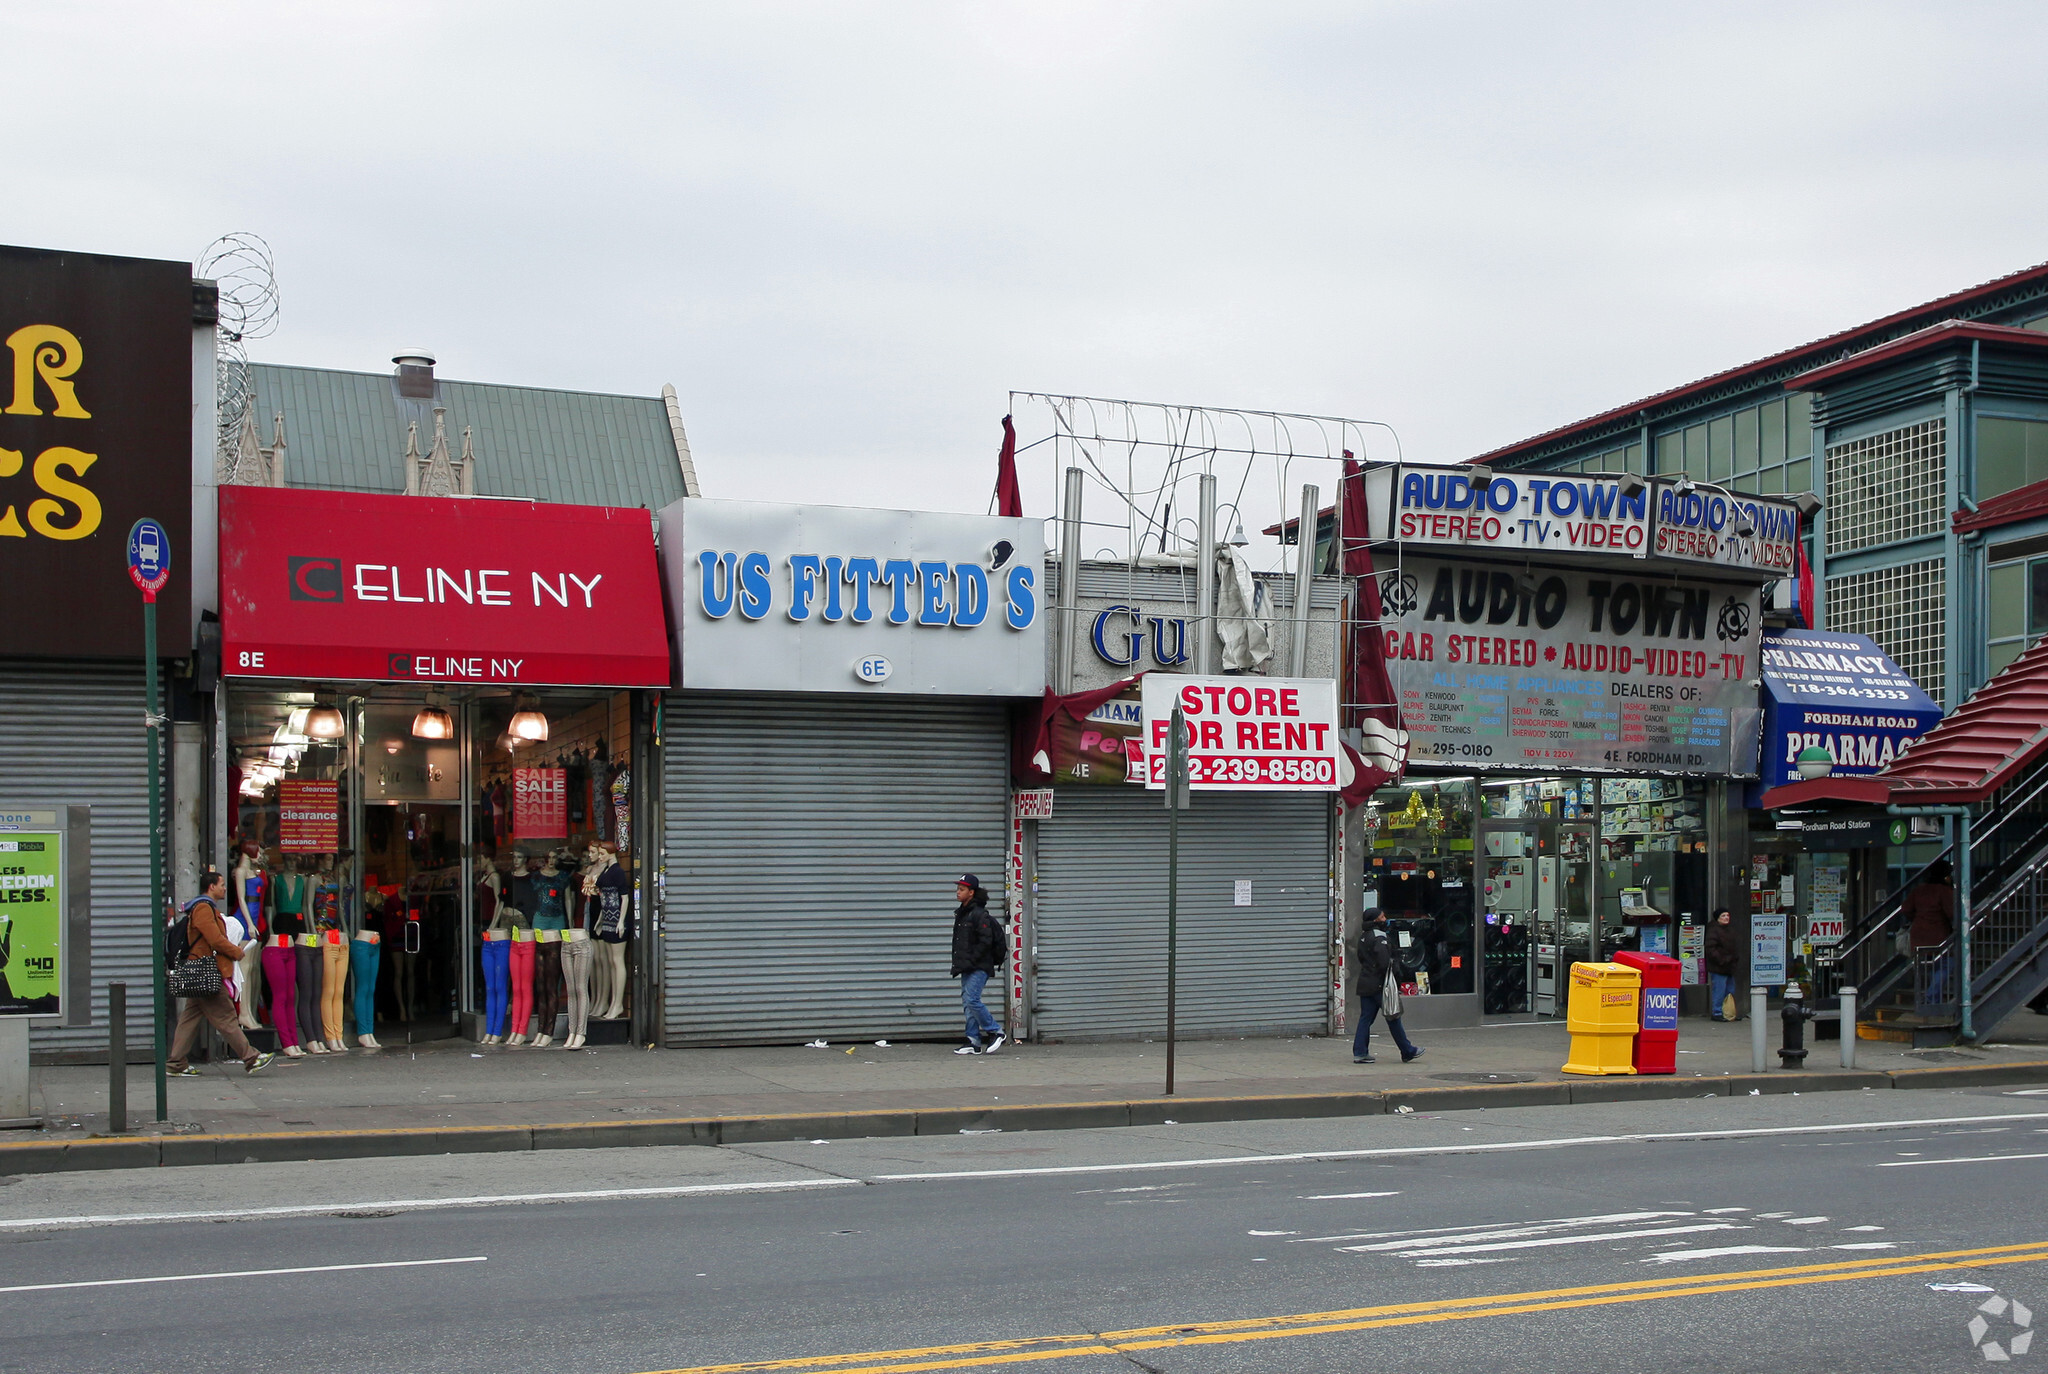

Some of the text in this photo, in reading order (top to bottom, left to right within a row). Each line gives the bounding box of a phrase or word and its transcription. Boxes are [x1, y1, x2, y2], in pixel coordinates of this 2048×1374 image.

[0, 324, 92, 419] R
[1400, 513, 1643, 549] STEREO TV VIDEO
[1657, 527, 1793, 568] STEREO TV VIDEO
[133, 568, 167, 589] NO STANDING
[697, 549, 772, 620] US
[531, 571, 602, 608] NY
[1423, 567, 1710, 640] AUDIO TOWN
[1384, 630, 1434, 661] CAR
[1446, 634, 1537, 667] STEREO
[1823, 641, 1860, 650] ROAD
[238, 651, 264, 668] 8E
[1762, 649, 1889, 675] PHARMACY
[490, 658, 523, 677] NY
[862, 660, 886, 676] 6E
[1432, 672, 1701, 701] ALL HOME APPLIANCES DEALERS OF:
[1787, 683, 1909, 700] 718-364-3333
[1181, 686, 1300, 716] STORE
[1403, 690, 1420, 698] SONY
[1425, 691, 1456, 700] KENWOOD
[1093, 703, 1142, 722] DIAM
[1403, 702, 1424, 710] ALPINE
[1429, 703, 1464, 711] BLAUPUNKT
[1540, 709, 1559, 717] FORCE
[1650, 704, 1670, 712] PENTAX
[1698, 707, 1723, 716] OLYMPUS
[1403, 713, 1425, 721] PHILIPS
[1430, 714, 1451, 722] ZENITH
[1644, 715, 1663, 723] CANON
[1804, 712, 1917, 729] FORDHAM ROAD
[1236, 721, 1330, 750] RENT
[1405, 724, 1438, 732] ANASONIC
[1441, 725, 1471, 734] TECHNICS
[1645, 725, 1668, 733] TOSHIBA
[1649, 735, 1669, 743] PROTON
[1688, 738, 1720, 746] PARASOUND
[1433, 743, 1493, 757] 295-0180
[1627, 751, 1681, 765] FORDHAM
[1687, 754, 1705, 766] RD.
[515, 769, 565, 781] SALE
[1071, 763, 1089, 778] 4E
[1153, 757, 1332, 782] 22-239-8580
[1788, 770, 1801, 780] FREE
[515, 781, 565, 792] SALE
[515, 792, 565, 803] SALE
[281, 810, 337, 820] clearance
[515, 803, 565, 815] SALE
[515, 814, 565, 826] SALE
[1802, 820, 1870, 831] Fordham Road Station
[1893, 825, 1901, 839] 4
[0, 875, 54, 889] EDOM
[1810, 922, 1842, 936] ATM
[24, 957, 54, 970] $40
[1650, 995, 1677, 1009] VOICE
